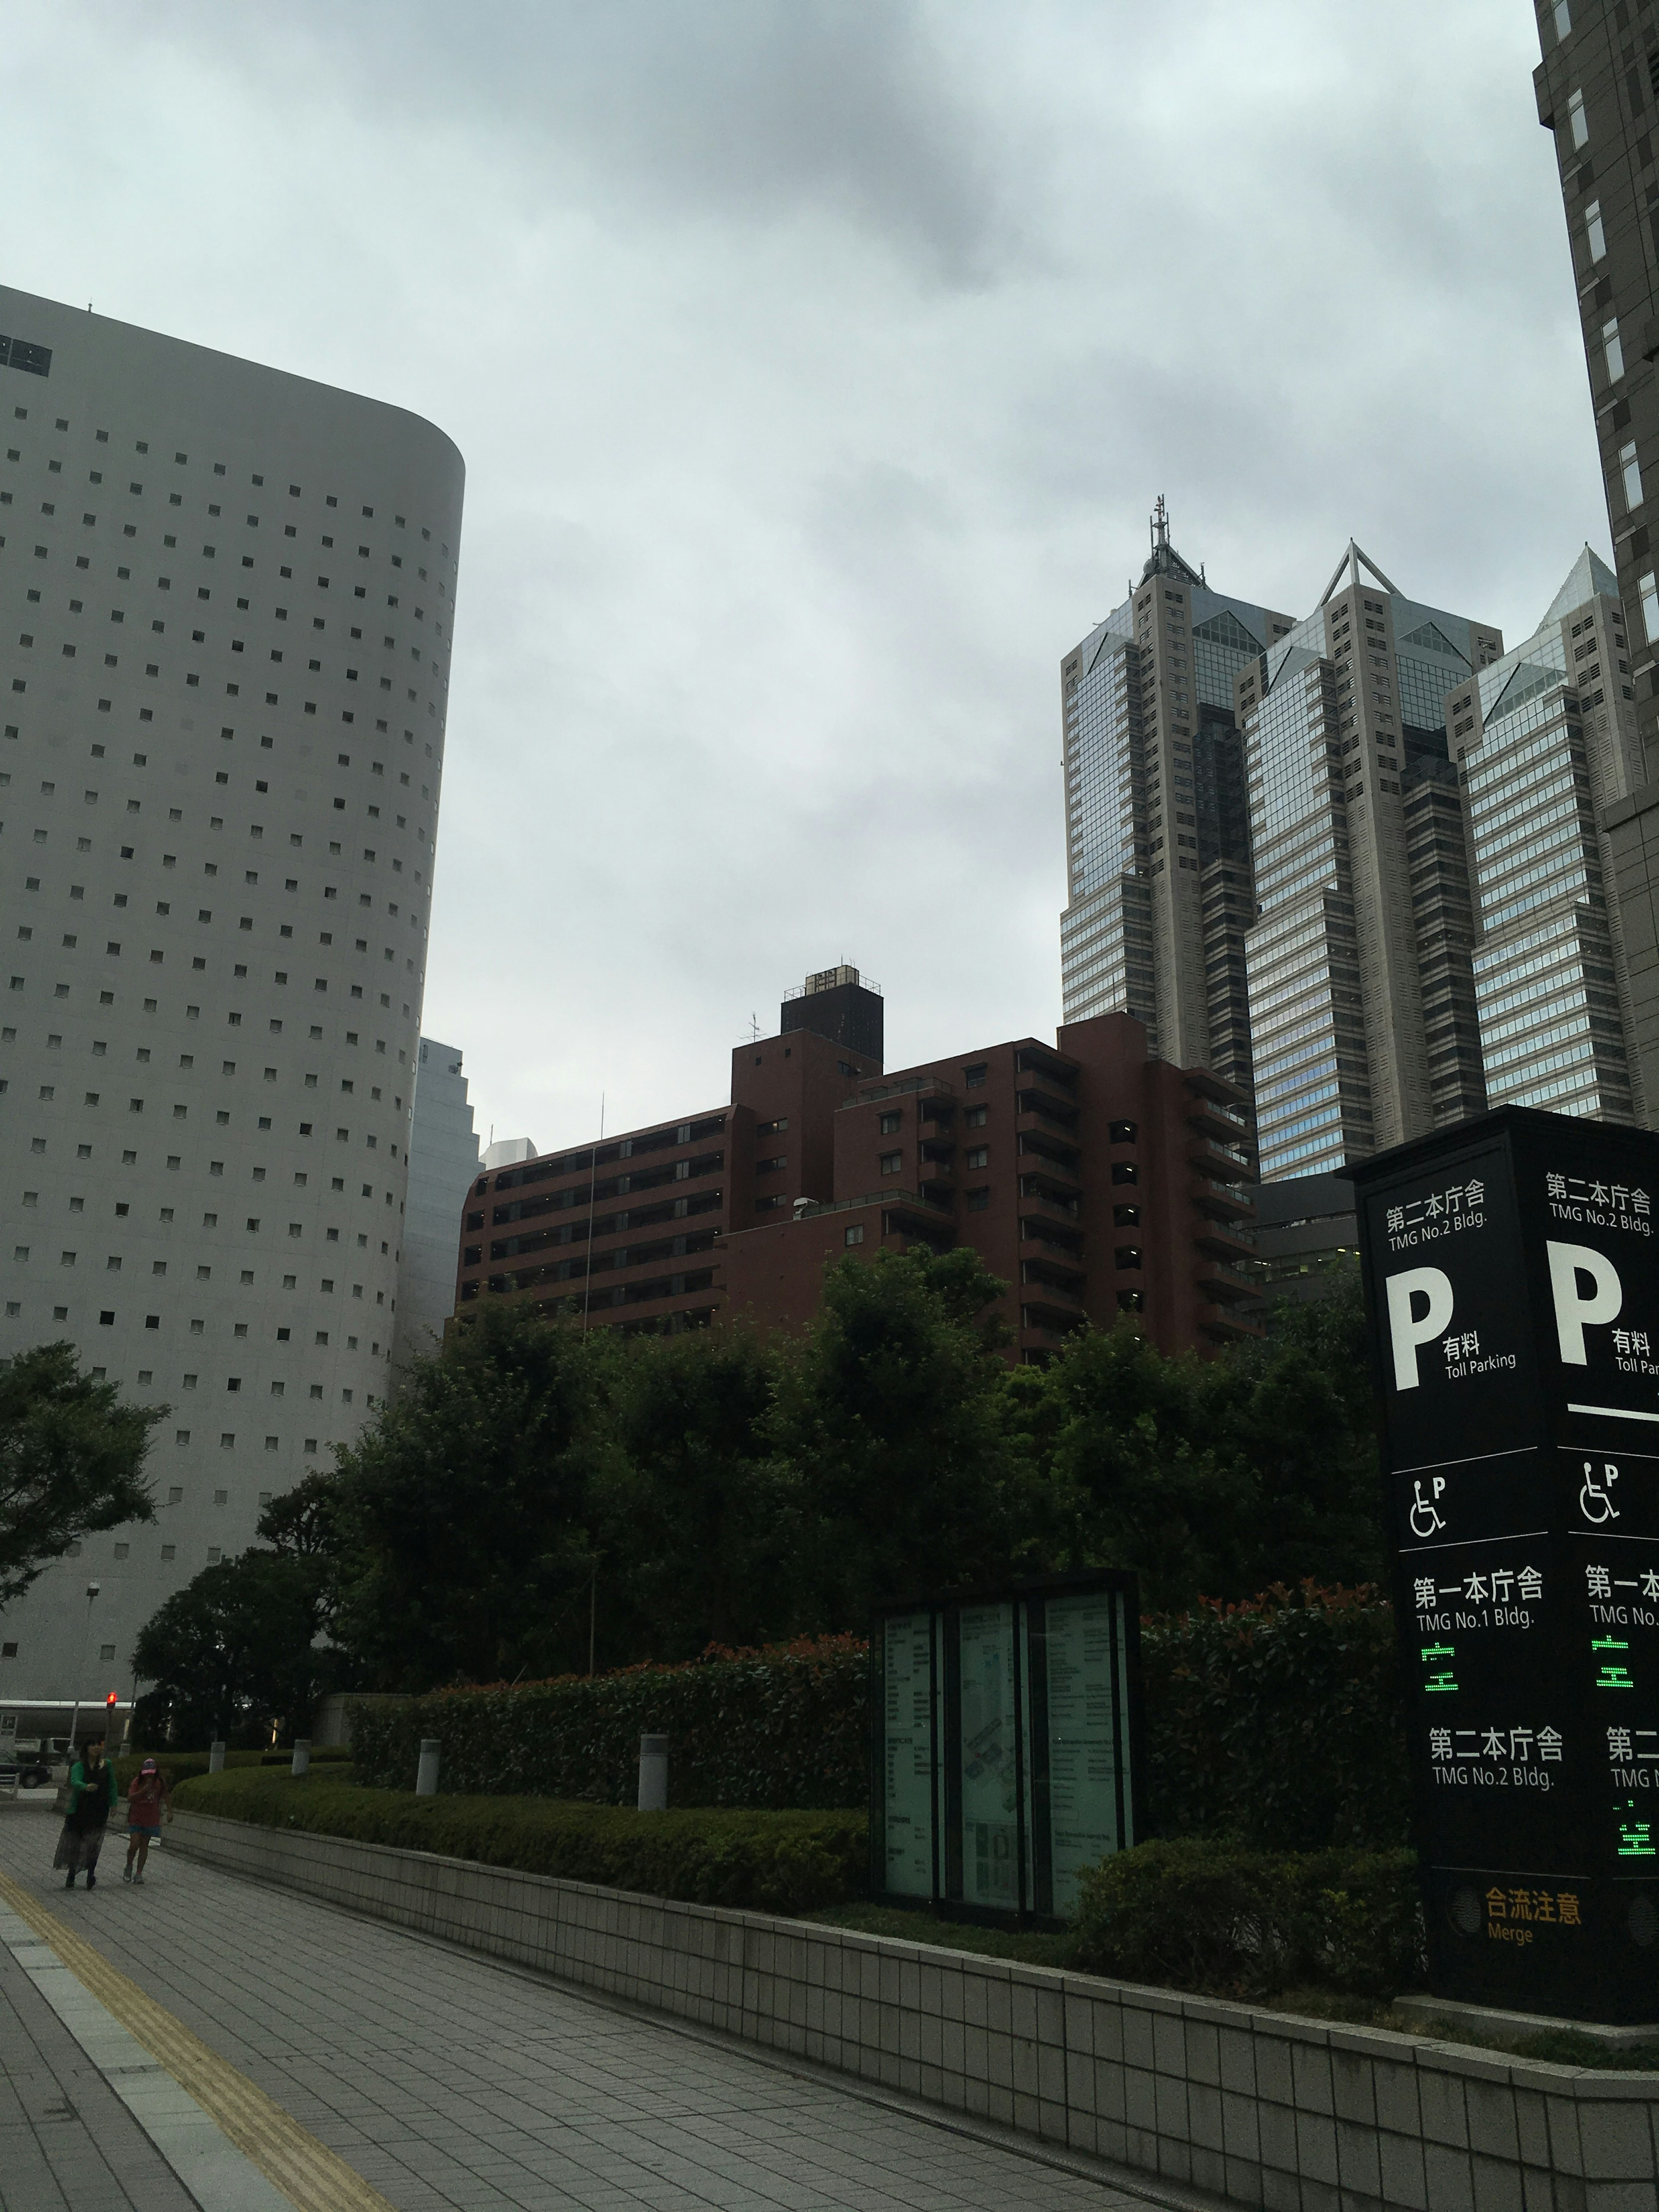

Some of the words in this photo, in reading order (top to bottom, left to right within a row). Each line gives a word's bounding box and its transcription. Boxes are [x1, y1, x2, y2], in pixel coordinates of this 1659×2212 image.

[1386, 1178, 1485, 1234] 第二本庁舎
[1545, 1171, 1651, 1215] 第二本庁舎
[1389, 1230, 1418, 1252] TMG
[1421, 1220, 1451, 1242] No.2
[1454, 1210, 1488, 1231] Bldg.
[1549, 1202, 1582, 1222] TMG
[1586, 1209, 1618, 1228] No.2
[1621, 1215, 1654, 1237] Bldg.
[1546, 1240, 1622, 1366] P
[1385, 1267, 1454, 1391] P
[1611, 1328, 1650, 1357] 有料
[1442, 1330, 1480, 1362] 有料
[1445, 1362, 1467, 1379] Toll
[1470, 1353, 1516, 1374] Parking
[1615, 1357, 1638, 1372] Toll
[1413, 1564, 1543, 1609] 第一本庁舎
[1416, 1613, 1451, 1632] TMG
[1456, 1610, 1488, 1629] No.1
[1494, 1606, 1535, 1629] Bldg.
[1589, 1605, 1628, 1625] TMG
[1429, 1726, 1563, 1762] 第二本庁舎
[1432, 1767, 1468, 1786] TMG
[1472, 1767, 1509, 1786] No.2
[1513, 1767, 1555, 1791] Bldg.
[1611, 1769, 1649, 1788] TMG
[1485, 1886, 1582, 1926] 合流注意
[1488, 1923, 1533, 1946] Merge
